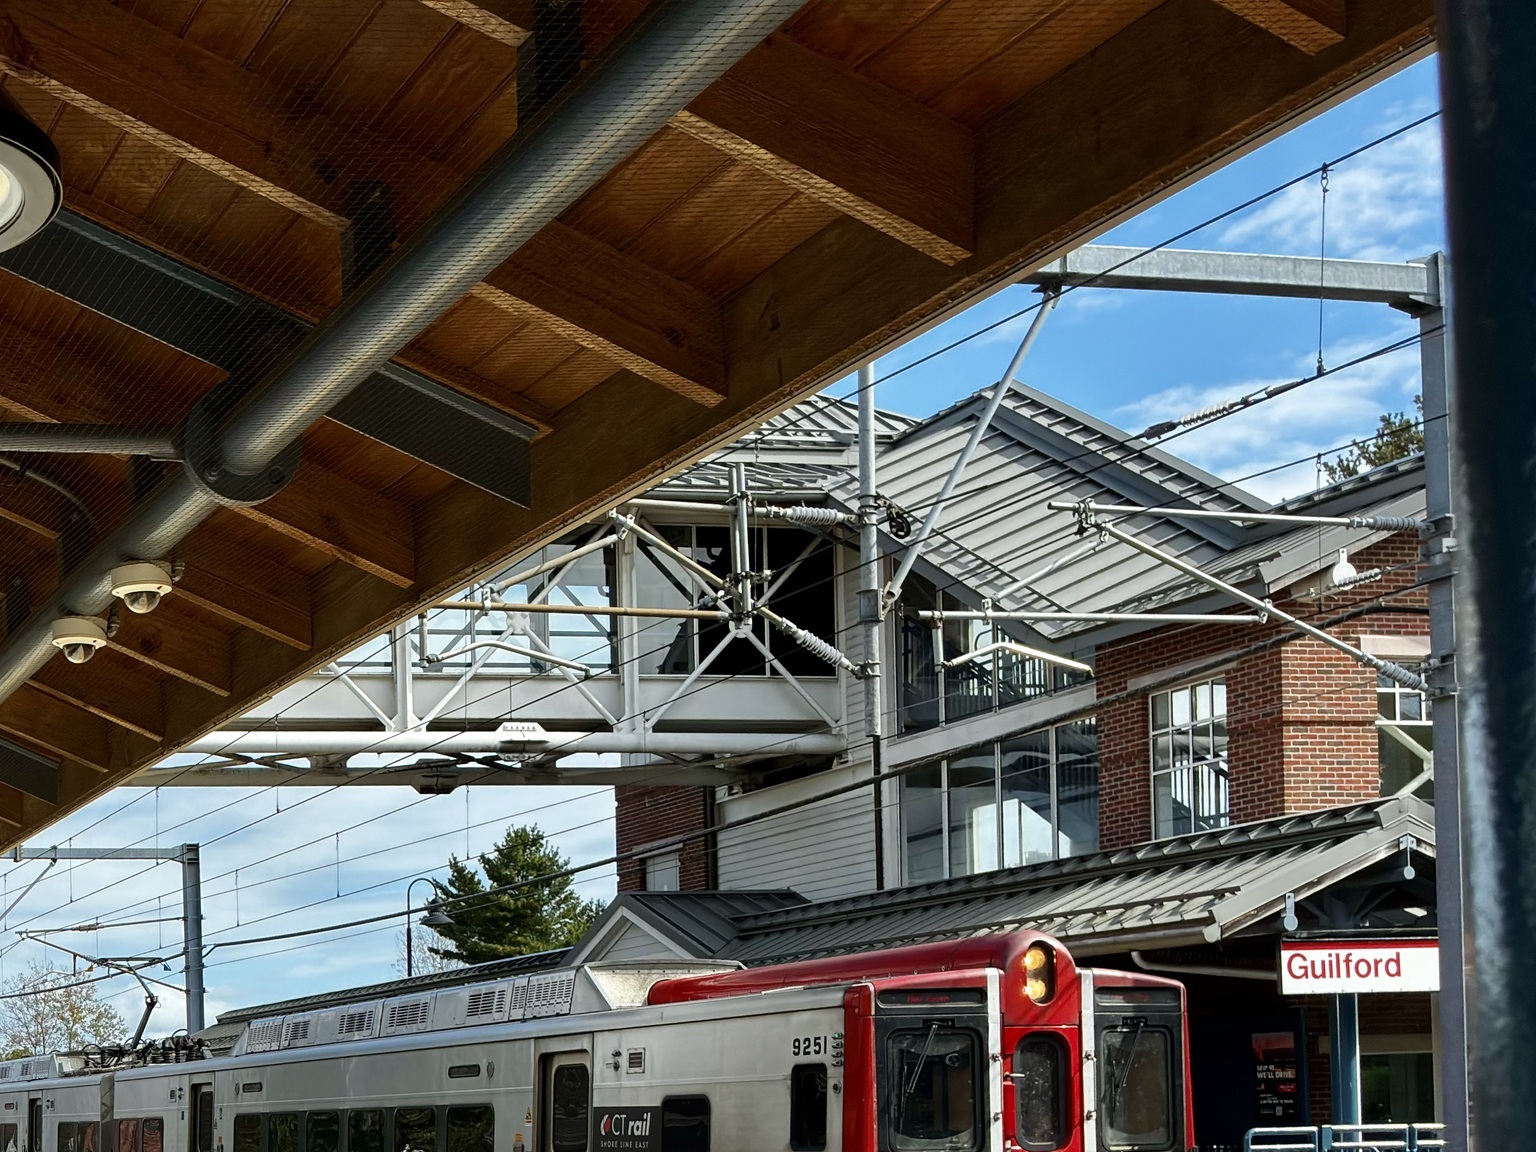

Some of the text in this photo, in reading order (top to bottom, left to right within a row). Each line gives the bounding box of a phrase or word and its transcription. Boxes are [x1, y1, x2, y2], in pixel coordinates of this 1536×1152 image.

[1287, 951, 1402, 980] Guilford
[792, 1036, 828, 1056] 9251
[600, 1140, 618, 1148] SHORE
[635, 1141, 649, 1149] EAST
